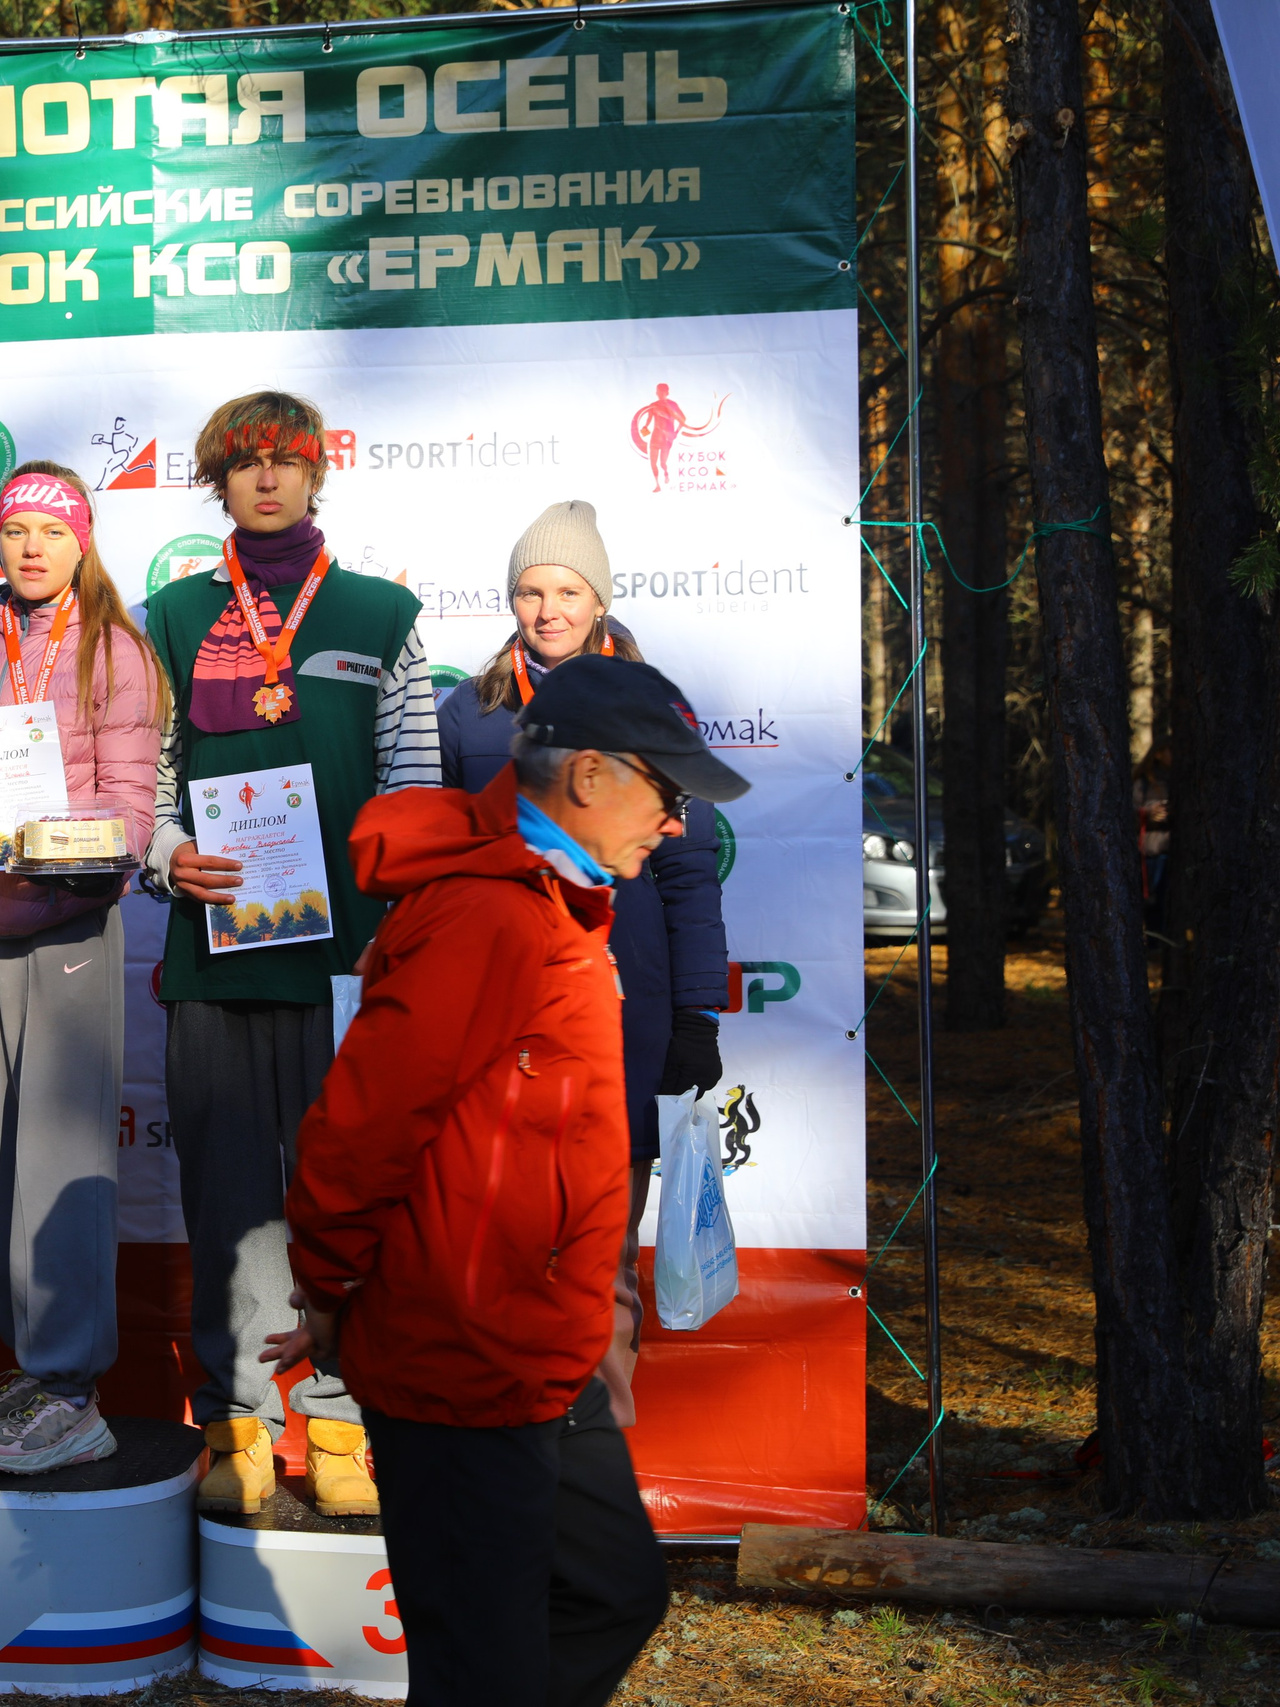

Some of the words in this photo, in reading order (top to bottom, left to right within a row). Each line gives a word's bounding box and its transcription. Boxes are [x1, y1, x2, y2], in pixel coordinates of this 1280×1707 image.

[356, 49, 729, 140] ОСЕНЬ
[283, 166, 702, 219] СОРЕВНОВАНИЯ
[133, 241, 292, 299] КСО
[326, 224, 702, 291] «ЕРМАК»
[368, 432, 561, 470] SPORTident
[678, 451, 726, 463] КУБОК
[678, 466, 709, 477] КСО
[241, 582, 254, 607] ОСЕНЬ
[612, 559, 809, 599] SPORTident
[289, 597, 309, 631] ЗОЛОТАЯ
[307, 576, 321, 598] ОСЕНЬ
[249, 607, 267, 643] ЗОЛОТАЯ
[46, 640, 60, 666] ОСЕНЬ
[275, 688, 285, 700] 3
[229, 814, 287, 834] ДИПЛОМ
[235, 831, 285, 843] НАГРАЖДАЕТСЯ
[360, 1567, 407, 1655] 3
